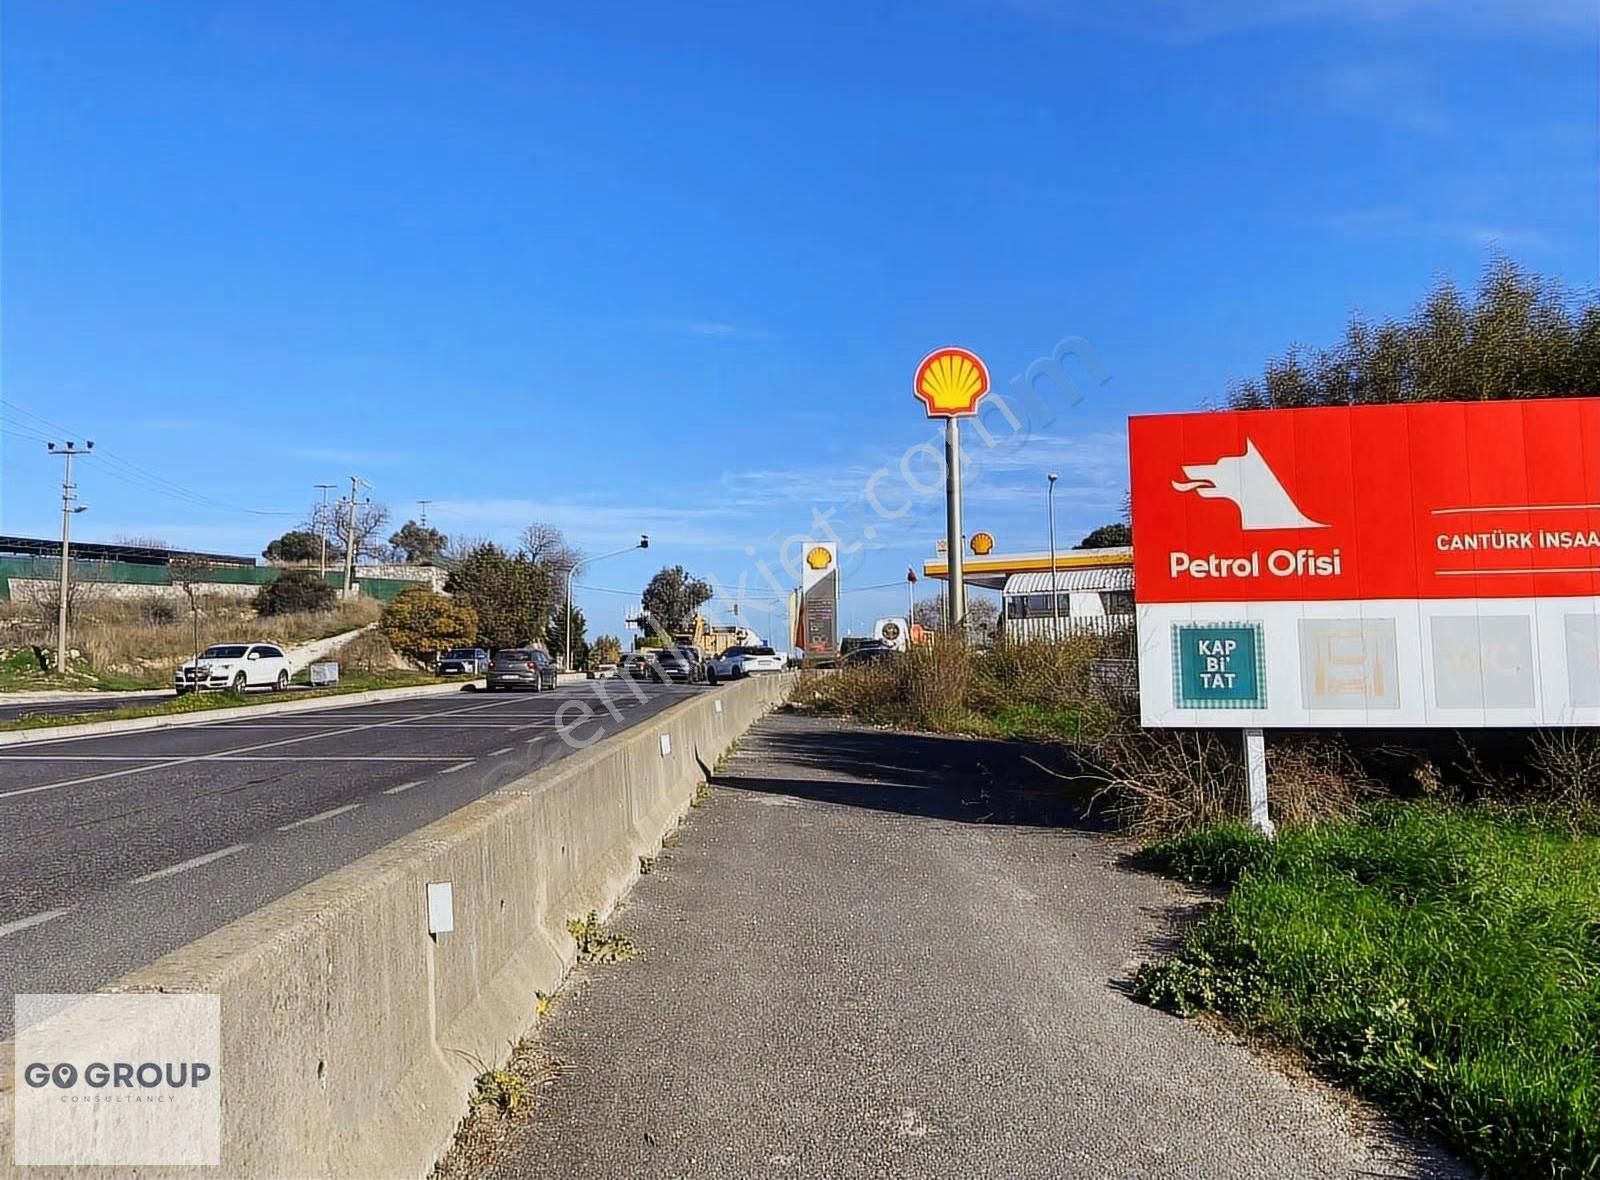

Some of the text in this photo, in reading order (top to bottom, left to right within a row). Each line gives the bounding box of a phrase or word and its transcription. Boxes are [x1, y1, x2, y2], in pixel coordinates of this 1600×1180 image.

[1436, 529, 1534, 551] CANTÜRK
[1169, 548, 1342, 578] Petrol Ofisi
[1198, 639, 1237, 655] KAP
[1199, 673, 1236, 689] TAT
